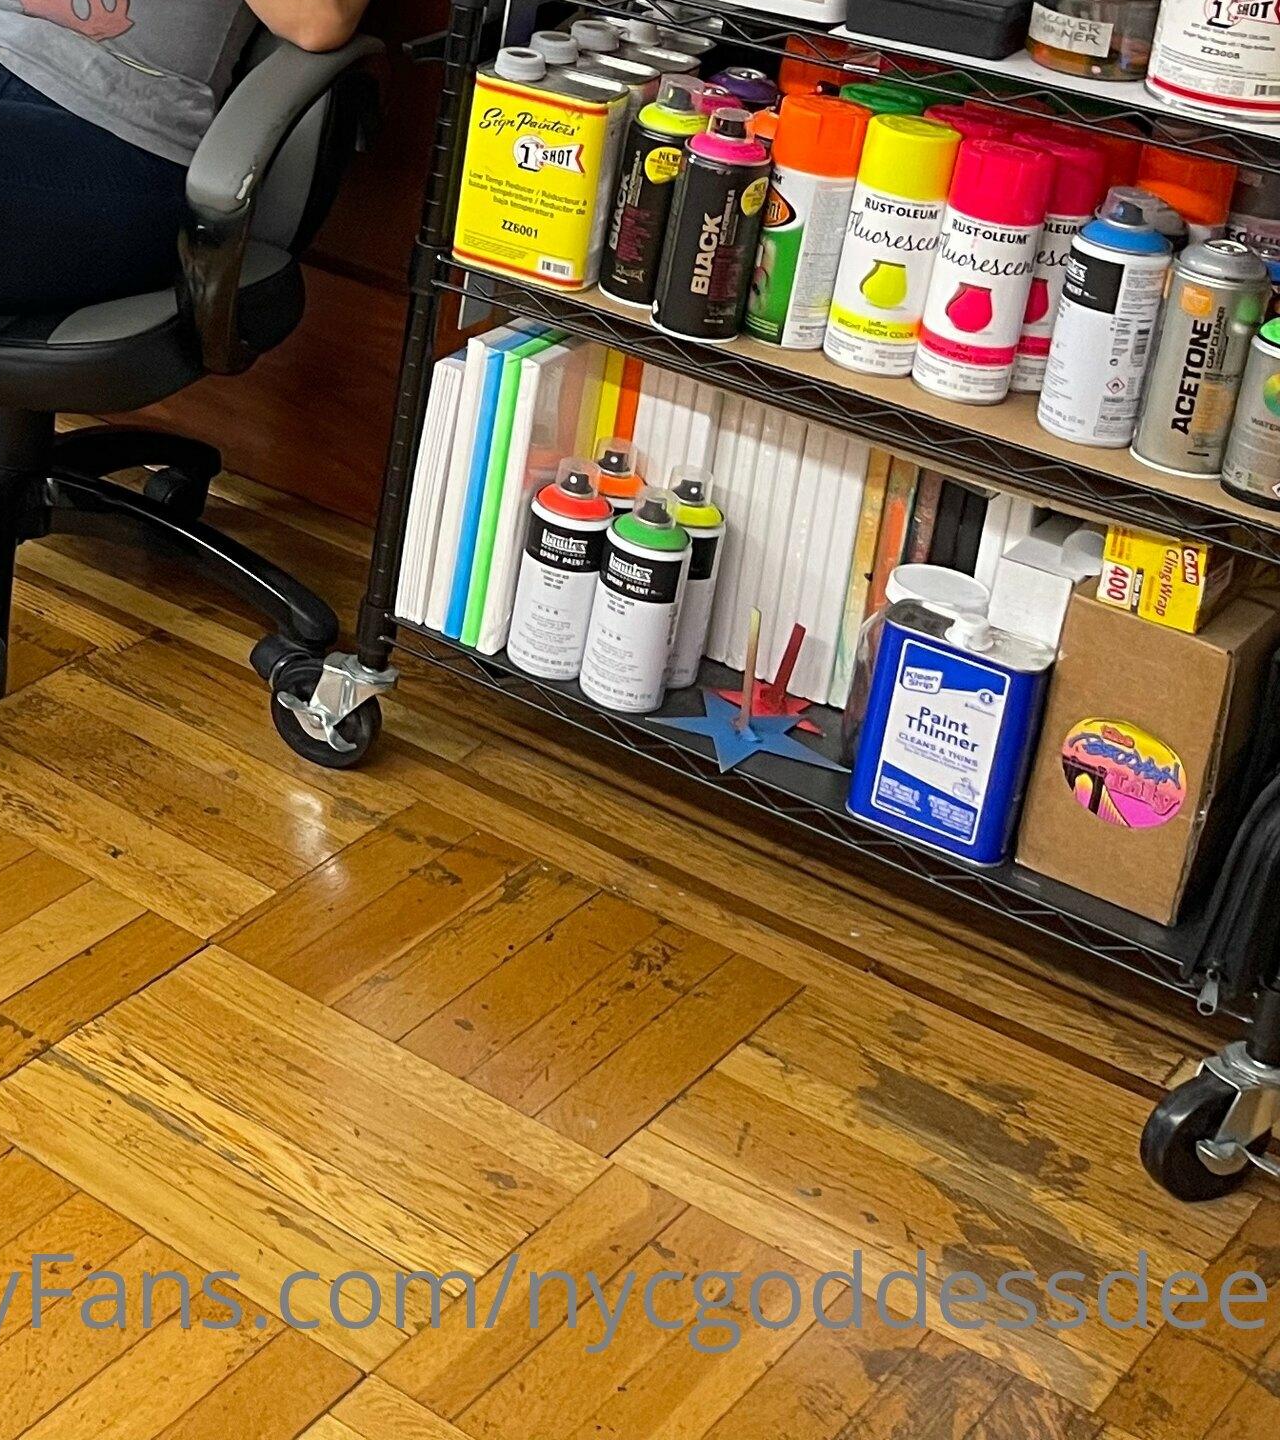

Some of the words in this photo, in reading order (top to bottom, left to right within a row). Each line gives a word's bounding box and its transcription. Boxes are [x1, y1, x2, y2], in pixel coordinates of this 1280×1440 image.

[1237, 1, 1274, 19] SHOT
[479, 107, 516, 136] Sign
[516, 111, 581, 137] Painters'
[542, 149, 572, 166] SHOT
[865, 196, 938, 220] RUST-OLEUM
[501, 218, 539, 239] ZZ6001
[951, 219, 1028, 244] RUST-OLEUM
[690, 212, 723, 296] BLACK
[1206, 347, 1216, 370] CAP
[1170, 319, 1213, 436] ACETONE
[539, 549, 560, 563] SPRAY
[562, 555, 585, 567] PAINT
[1183, 548, 1199, 584] GLAD
[606, 572, 624, 589] SPRAY
[626, 582, 650, 596] PAINT
[1107, 566, 1129, 601] 400
[905, 670, 939, 682] Klean
[907, 678, 935, 690] Strip
[919, 705, 970, 736] Paint
[905, 714, 980, 753] Thinner
[898, 731, 937, 752] CLEANS
[948, 749, 979, 768] THINS
